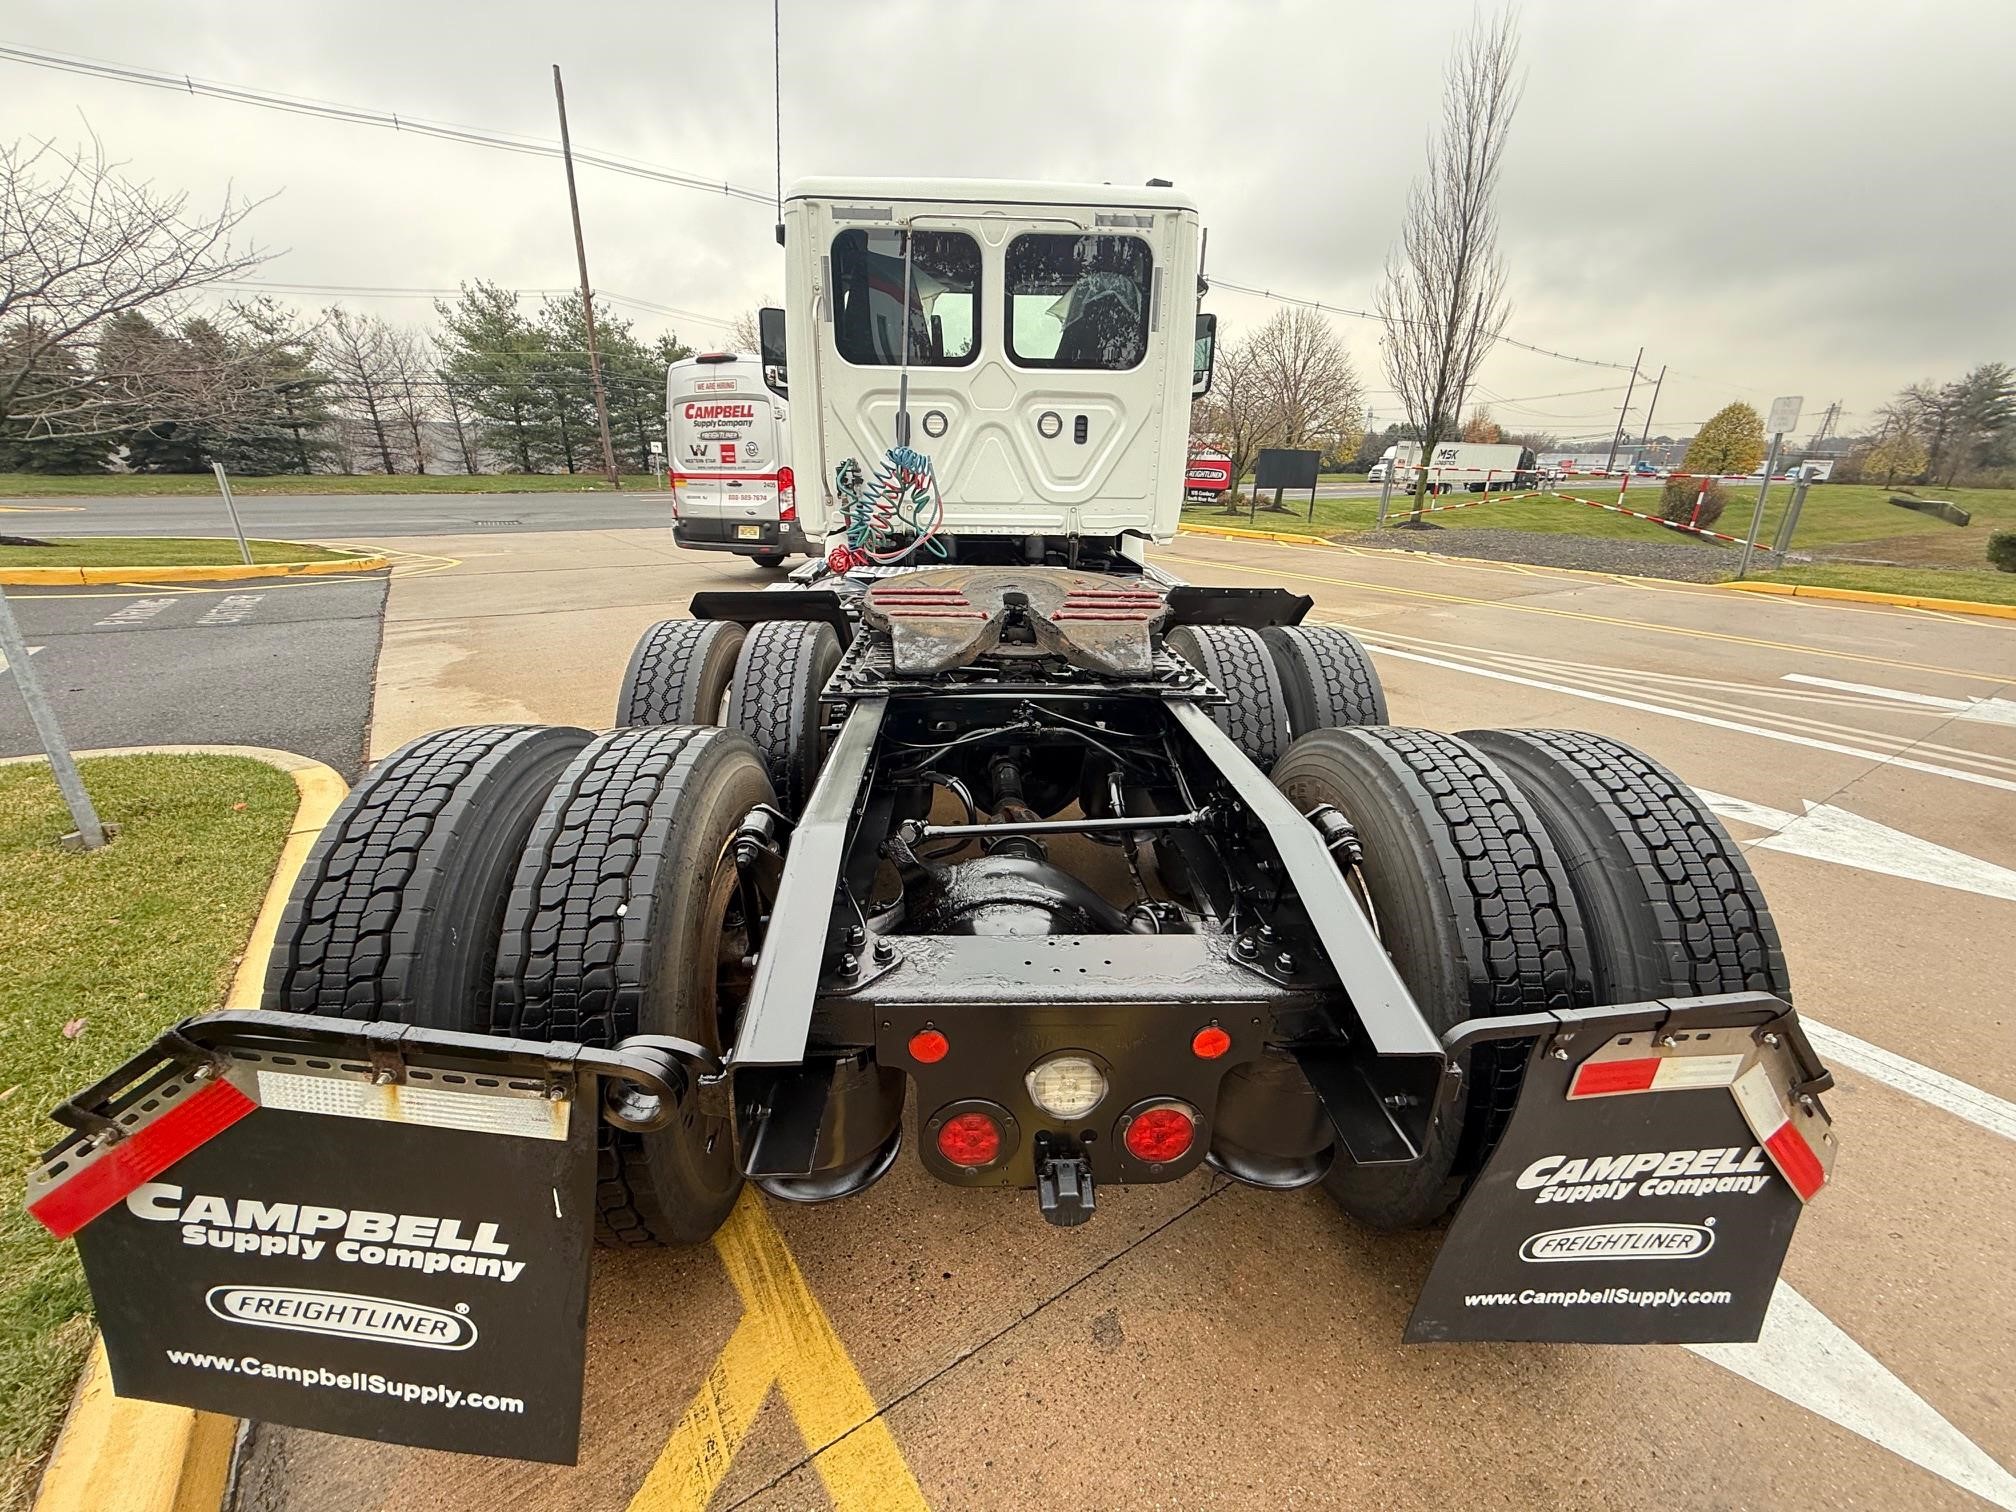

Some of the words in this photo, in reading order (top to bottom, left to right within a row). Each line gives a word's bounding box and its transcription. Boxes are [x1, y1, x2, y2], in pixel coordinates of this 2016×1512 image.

[685, 403, 754, 419] CAMPBELL
[718, 419, 753, 427] Company
[1437, 449, 1459, 460] MSK
[1516, 1146, 1768, 1190] CAMPBELL
[1535, 1180, 1637, 1204] Supply
[1638, 1175, 1771, 1196] Company
[126, 1182, 511, 1256] CAMPBELL
[182, 1226, 327, 1260] Supply
[335, 1241, 526, 1283] Company
[1540, 1233, 1694, 1253] FREIGHTLINER
[1465, 1287, 1731, 1308] www.CampbellSupply.com
[237, 1295, 449, 1338] FREIGHTLINER
[166, 1348, 525, 1414] www.CampbellSupply.com
